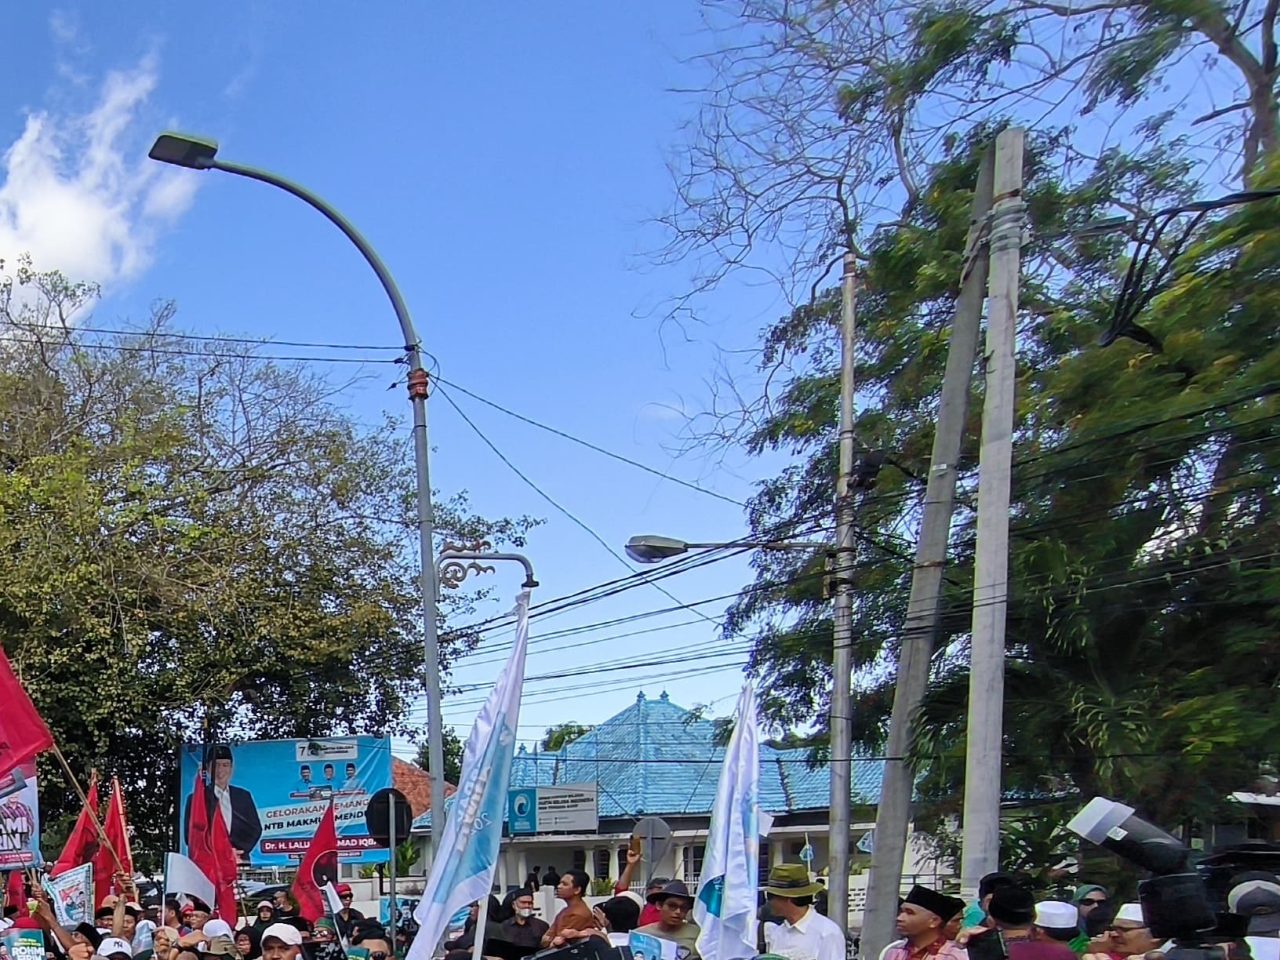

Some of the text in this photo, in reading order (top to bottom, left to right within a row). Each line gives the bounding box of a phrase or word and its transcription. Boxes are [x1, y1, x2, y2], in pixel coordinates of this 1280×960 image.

[299, 746, 306, 756] 7
[266, 804, 326, 819] GELORAKAN
[264, 820, 284, 831] NTB
[289, 841, 311, 849] LALU
